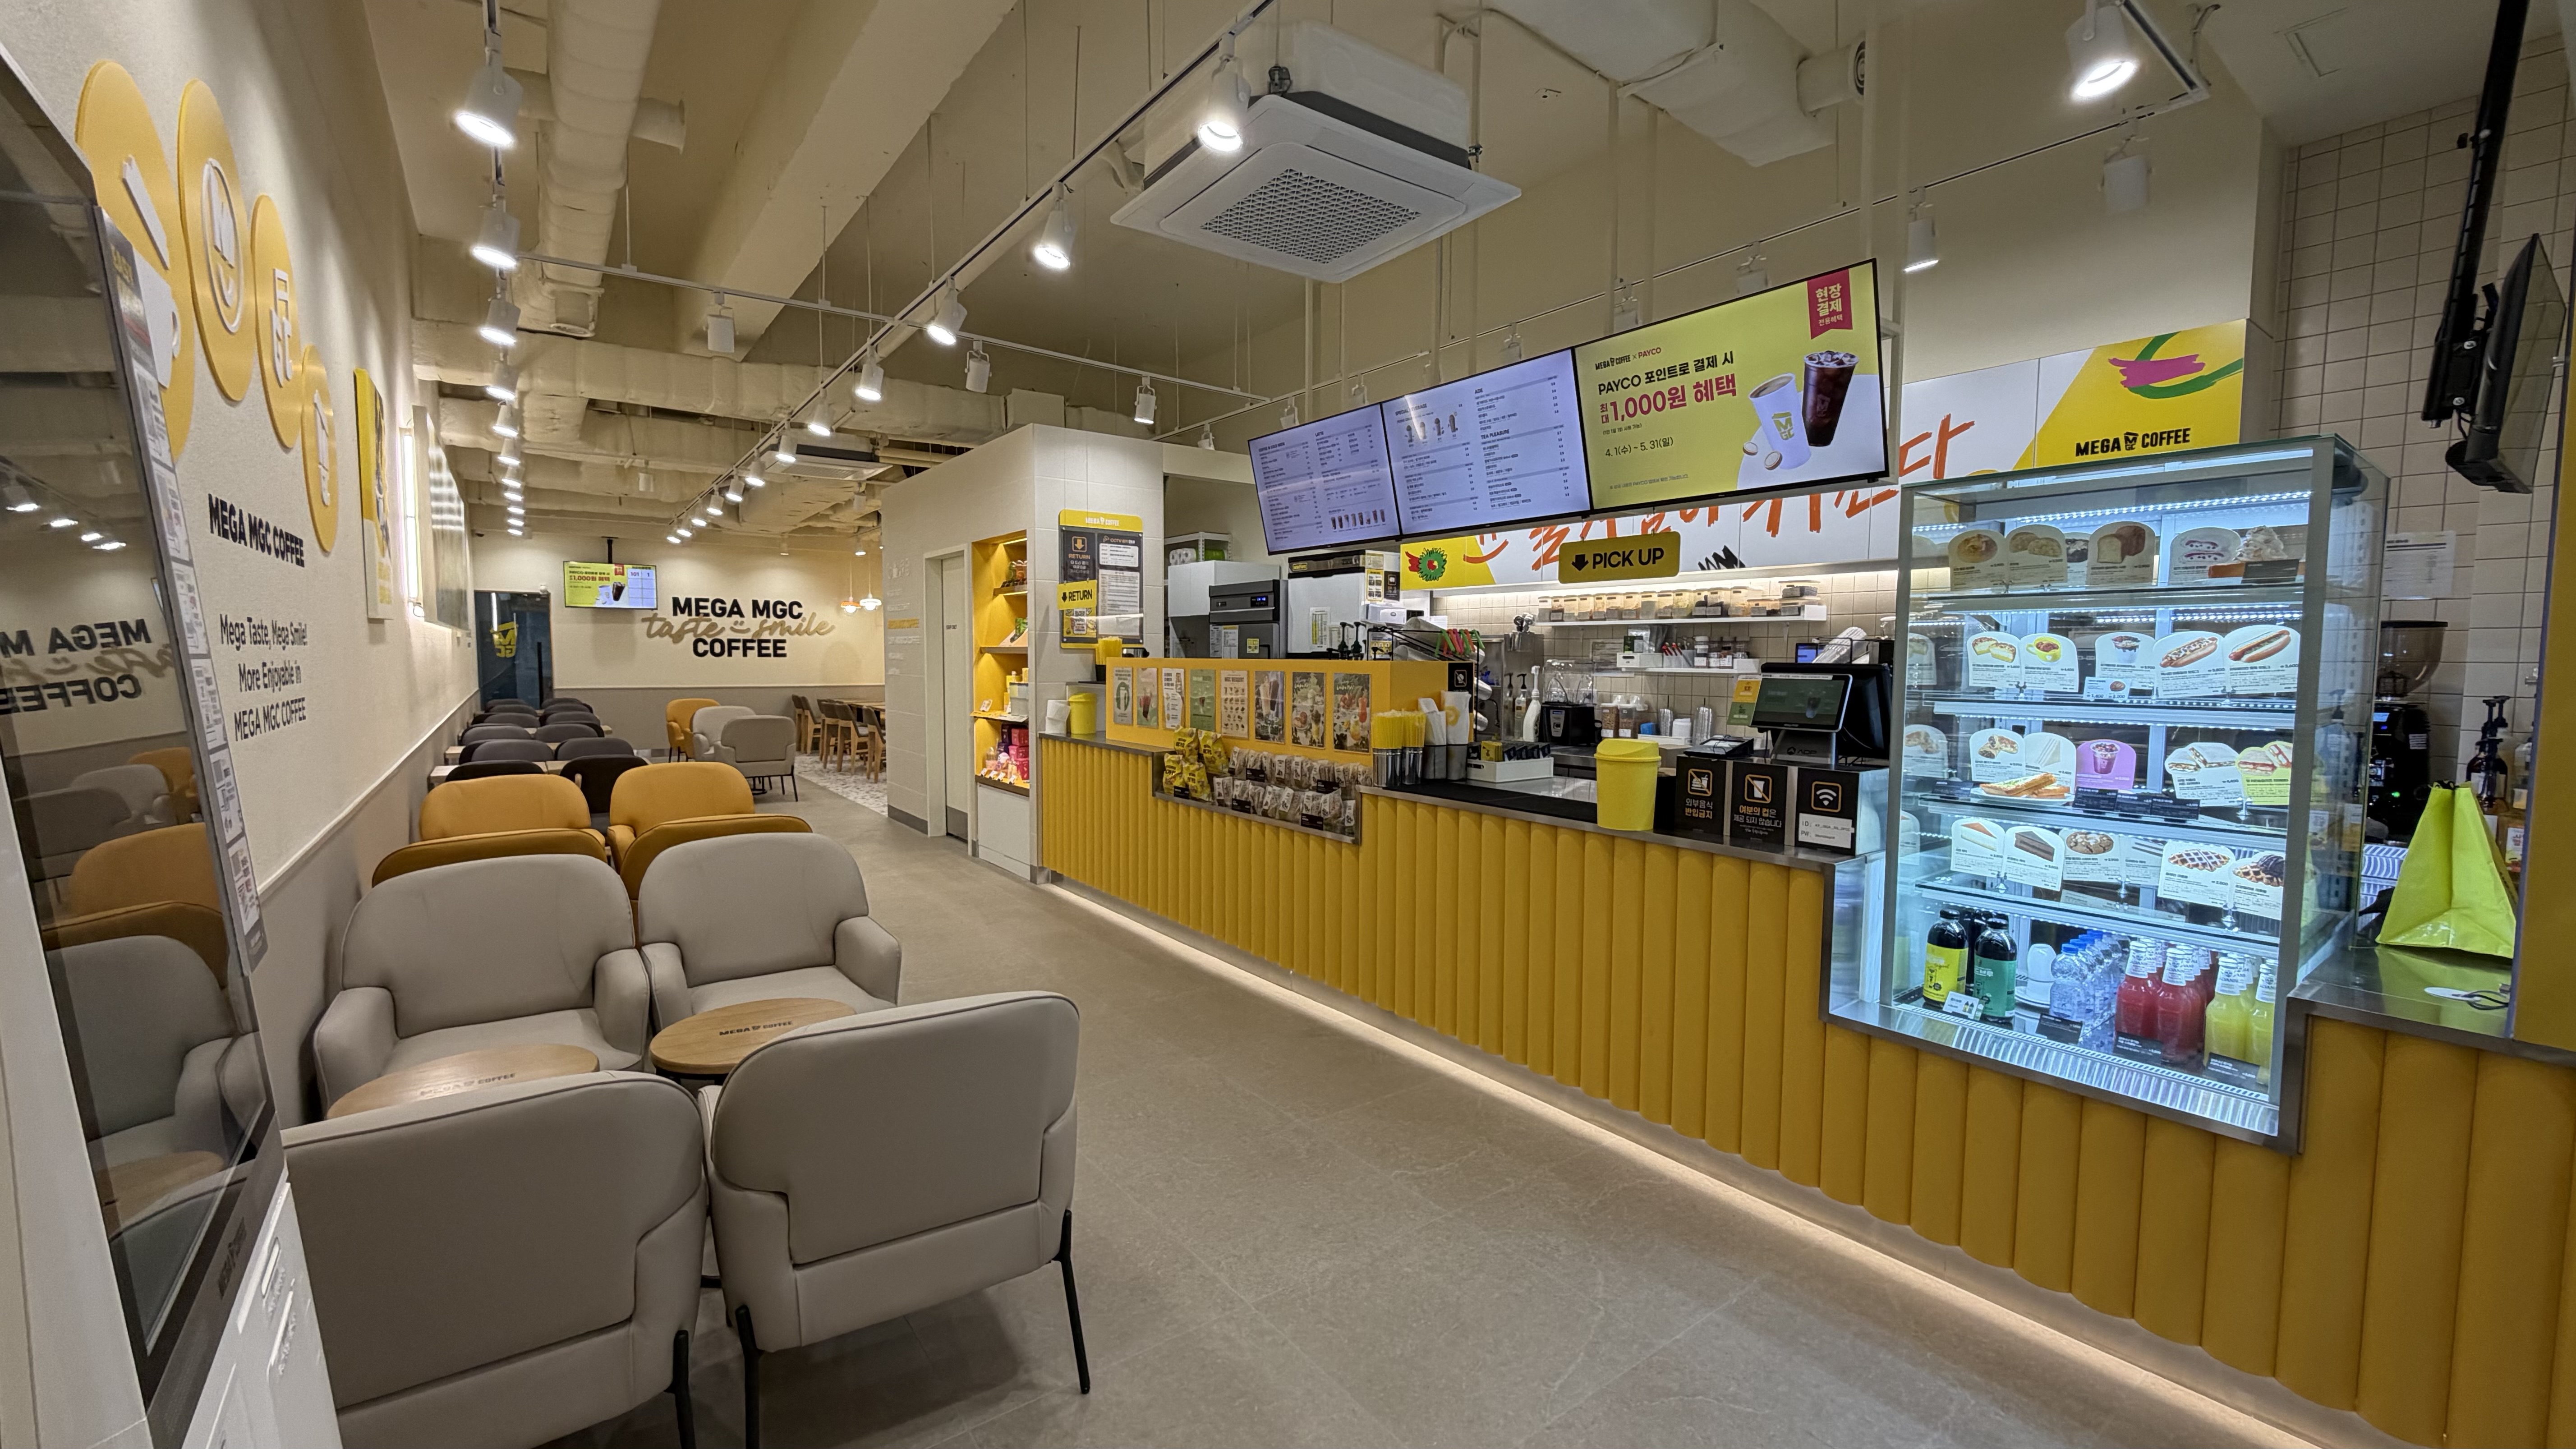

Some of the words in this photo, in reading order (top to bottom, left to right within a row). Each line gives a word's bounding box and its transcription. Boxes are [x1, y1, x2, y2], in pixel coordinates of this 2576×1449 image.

[1815, 283, 1842, 303] 현장
[1817, 298, 1842, 317] 결제
[1595, 360, 1610, 370] MEGA
[1615, 354, 1631, 365] COFFEE
[1638, 347, 1661, 359] PAYCO
[1598, 375, 1641, 395] PAYCO
[1645, 362, 1690, 384] 포인트로
[1693, 355, 1718, 372] 결제
[1722, 351, 1734, 365] 시
[1610, 385, 1687, 422] 1,000원
[1693, 373, 1736, 403] 혜택
[1490, 429, 1510, 438] PLEASURE
[2075, 437, 2121, 457] MEGA
[2141, 428, 2191, 448] COFFEE
[208, 493, 248, 547] MEGA
[248, 513, 271, 556] MGC
[273, 526, 305, 568] COFFEE
[1592, 549, 1634, 570] PICK
[1638, 547, 1664, 565] UP
[1068, 589, 1092, 602] RETURN
[672, 597, 745, 618] MEGA
[752, 599, 803, 619] MGC
[220, 614, 246, 651] Mega
[247, 617, 271, 650] Taste,
[271, 620, 289, 650] Mega
[641, 612, 725, 644] taste
[751, 612, 836, 639] smile
[693, 638, 787, 658] COFFEE
[238, 663, 260, 692] More
[262, 660, 294, 693] Enjoyable
[295, 660, 301, 684] in
[234, 708, 262, 741] MEGA
[263, 703, 280, 733] MGC
[281, 697, 306, 727] COFFEE
[1685, 798, 1713, 809] 외부음식
[1685, 807, 1712, 819] 반입금지
[1739, 805, 1760, 816] 여분의
[1762, 808, 1776, 819] 컵은
[1733, 814, 1744, 823] 제공
[1746, 816, 1757, 824] 되지
[1758, 818, 1781, 828] 않습니다
[719, 1027, 750, 1035] MEGA
[763, 1021, 792, 1029] COFFEE
